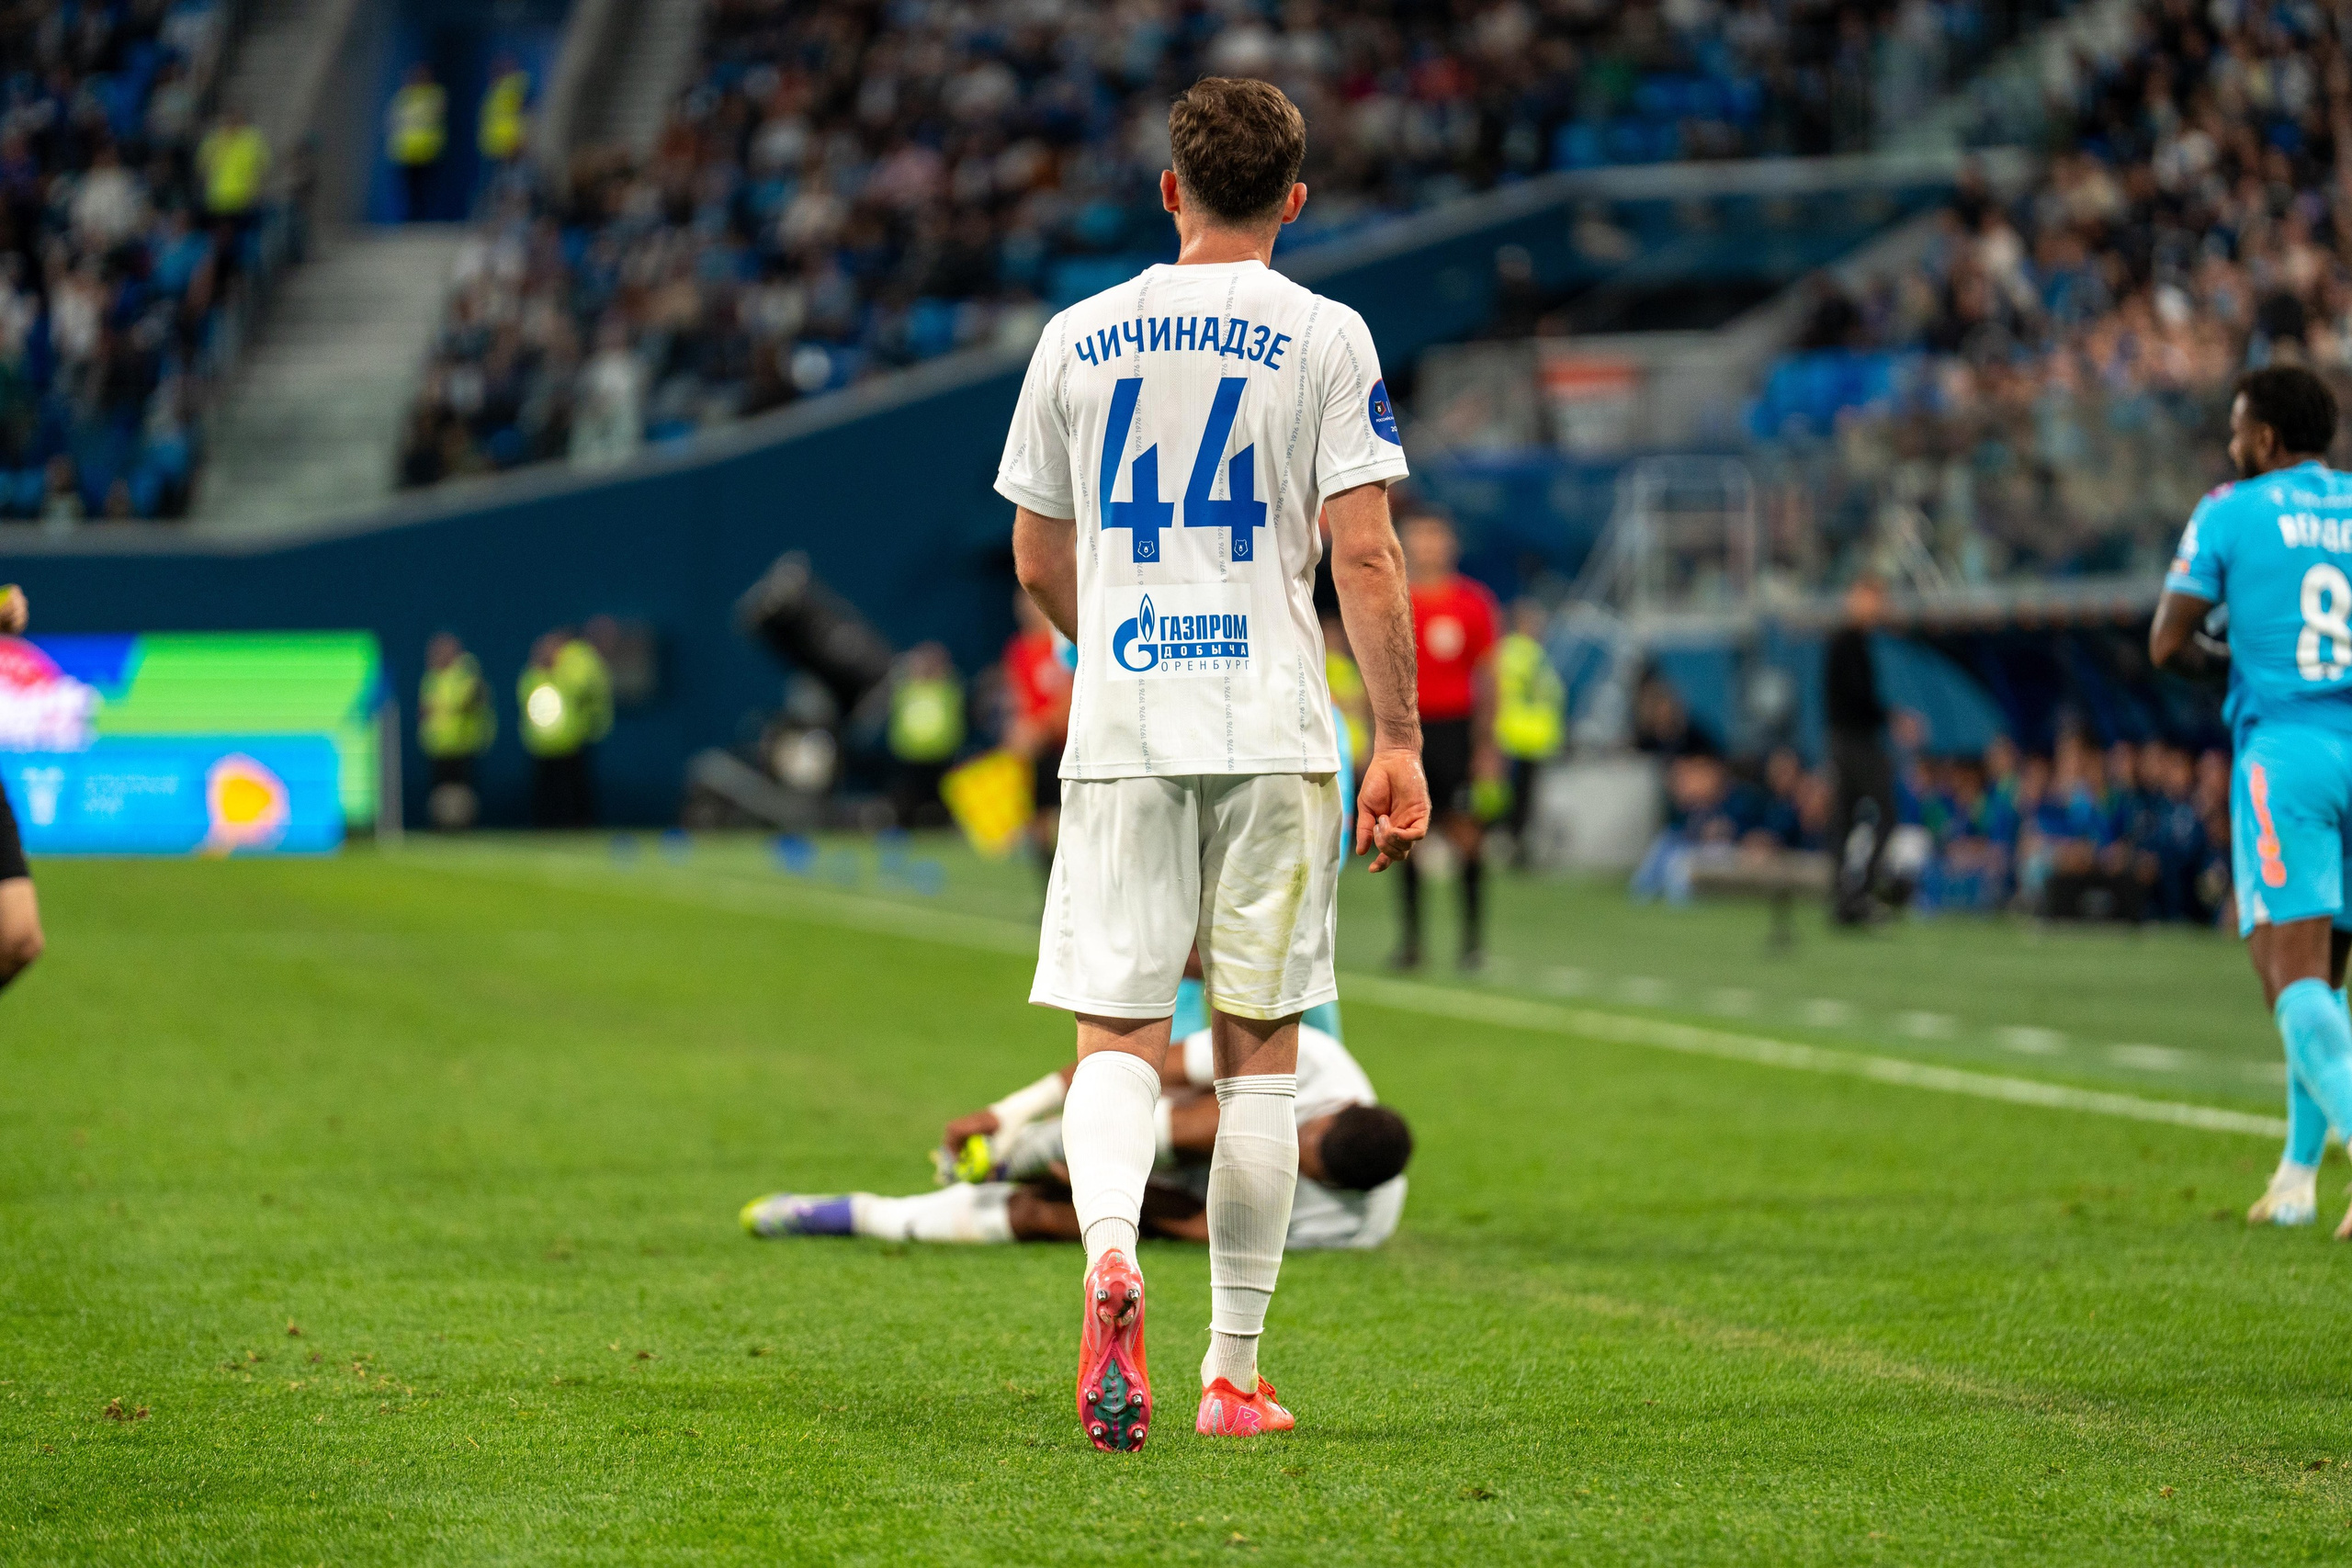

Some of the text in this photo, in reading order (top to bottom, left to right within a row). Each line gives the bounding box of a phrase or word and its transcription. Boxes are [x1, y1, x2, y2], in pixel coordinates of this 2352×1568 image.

[1136, 298, 1146, 311] 1976
[1226, 297, 1234, 310] 1976
[1223, 313, 1231, 327] 1976
[1305, 324, 1314, 338] 1976
[1075, 317, 1292, 371] ЧИЧИНАДЗЕ
[1301, 340, 1310, 355] 1976
[1346, 342, 1355, 357] 1976
[1351, 356, 1360, 372] 1976
[1296, 391, 1305, 407] 1976
[1357, 390, 1365, 407] 1976
[1291, 426, 1300, 443] 1976
[1363, 424, 1372, 440] 1976
[1286, 444, 1295, 459] 1976
[1008, 458, 1019, 472] 1976
[1100, 378, 1267, 563] 44
[1280, 479, 1289, 494] 1976
[1275, 497, 1284, 512] 1976
[1219, 560, 1227, 576] 1976
[1159, 614, 1248, 641] ГАЗПРОМ
[2296, 562, 2352, 682] 8
[1163, 645, 1247, 659] ДОБЫЧА
[1160, 660, 1250, 672] ОРЕНБУРГ
